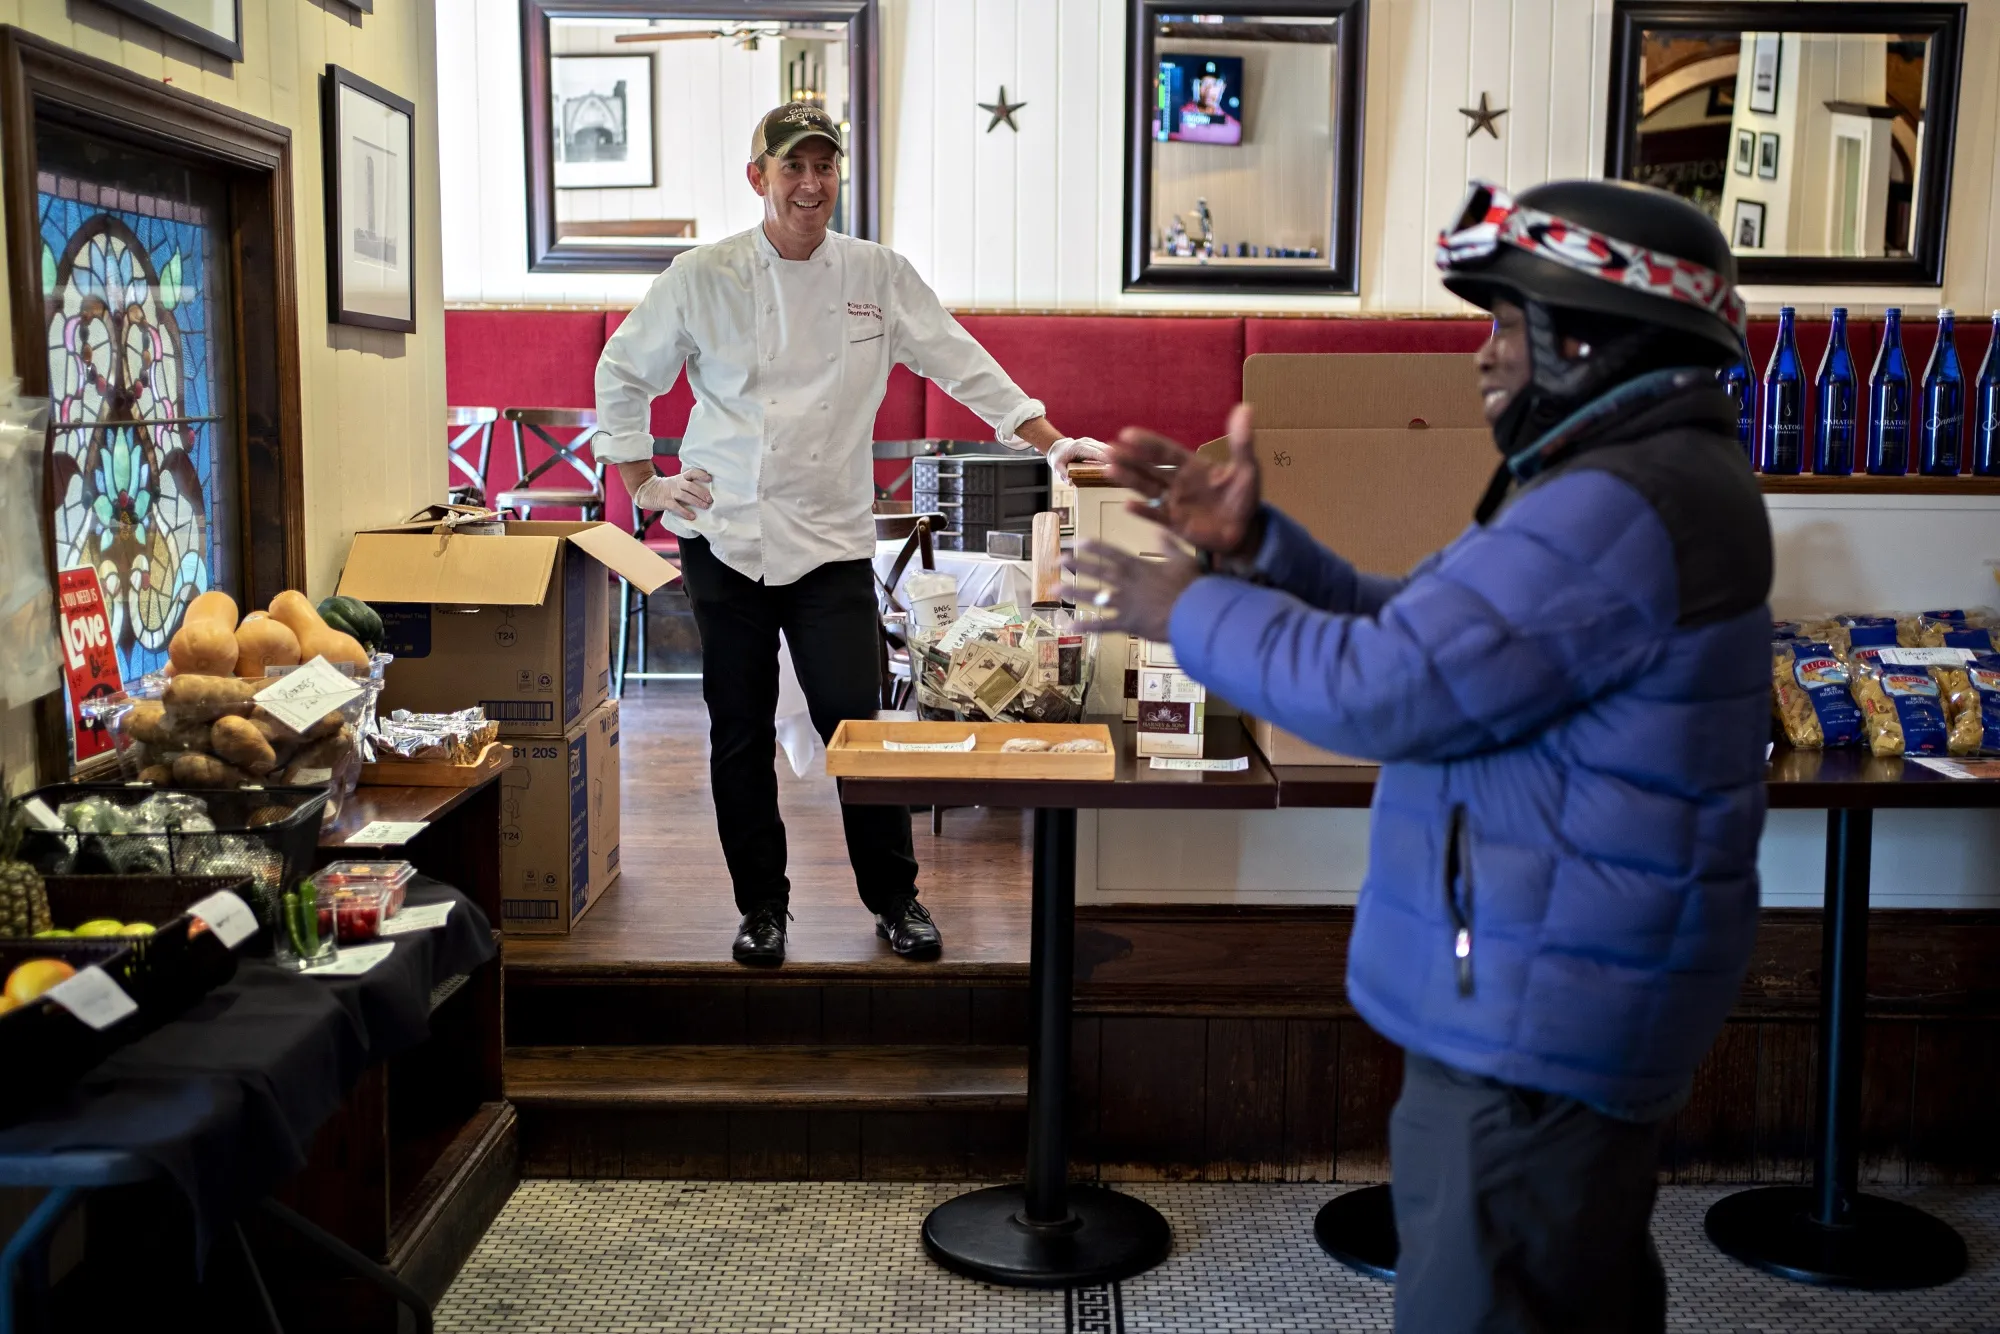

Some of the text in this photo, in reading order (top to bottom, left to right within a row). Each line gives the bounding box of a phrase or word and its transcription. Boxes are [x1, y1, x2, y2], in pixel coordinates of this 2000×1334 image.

[789, 107, 812, 115] CHEF
[497, 631, 515, 641] T24
[512, 747, 559, 759] 61 20S
[503, 832, 520, 841] T24
